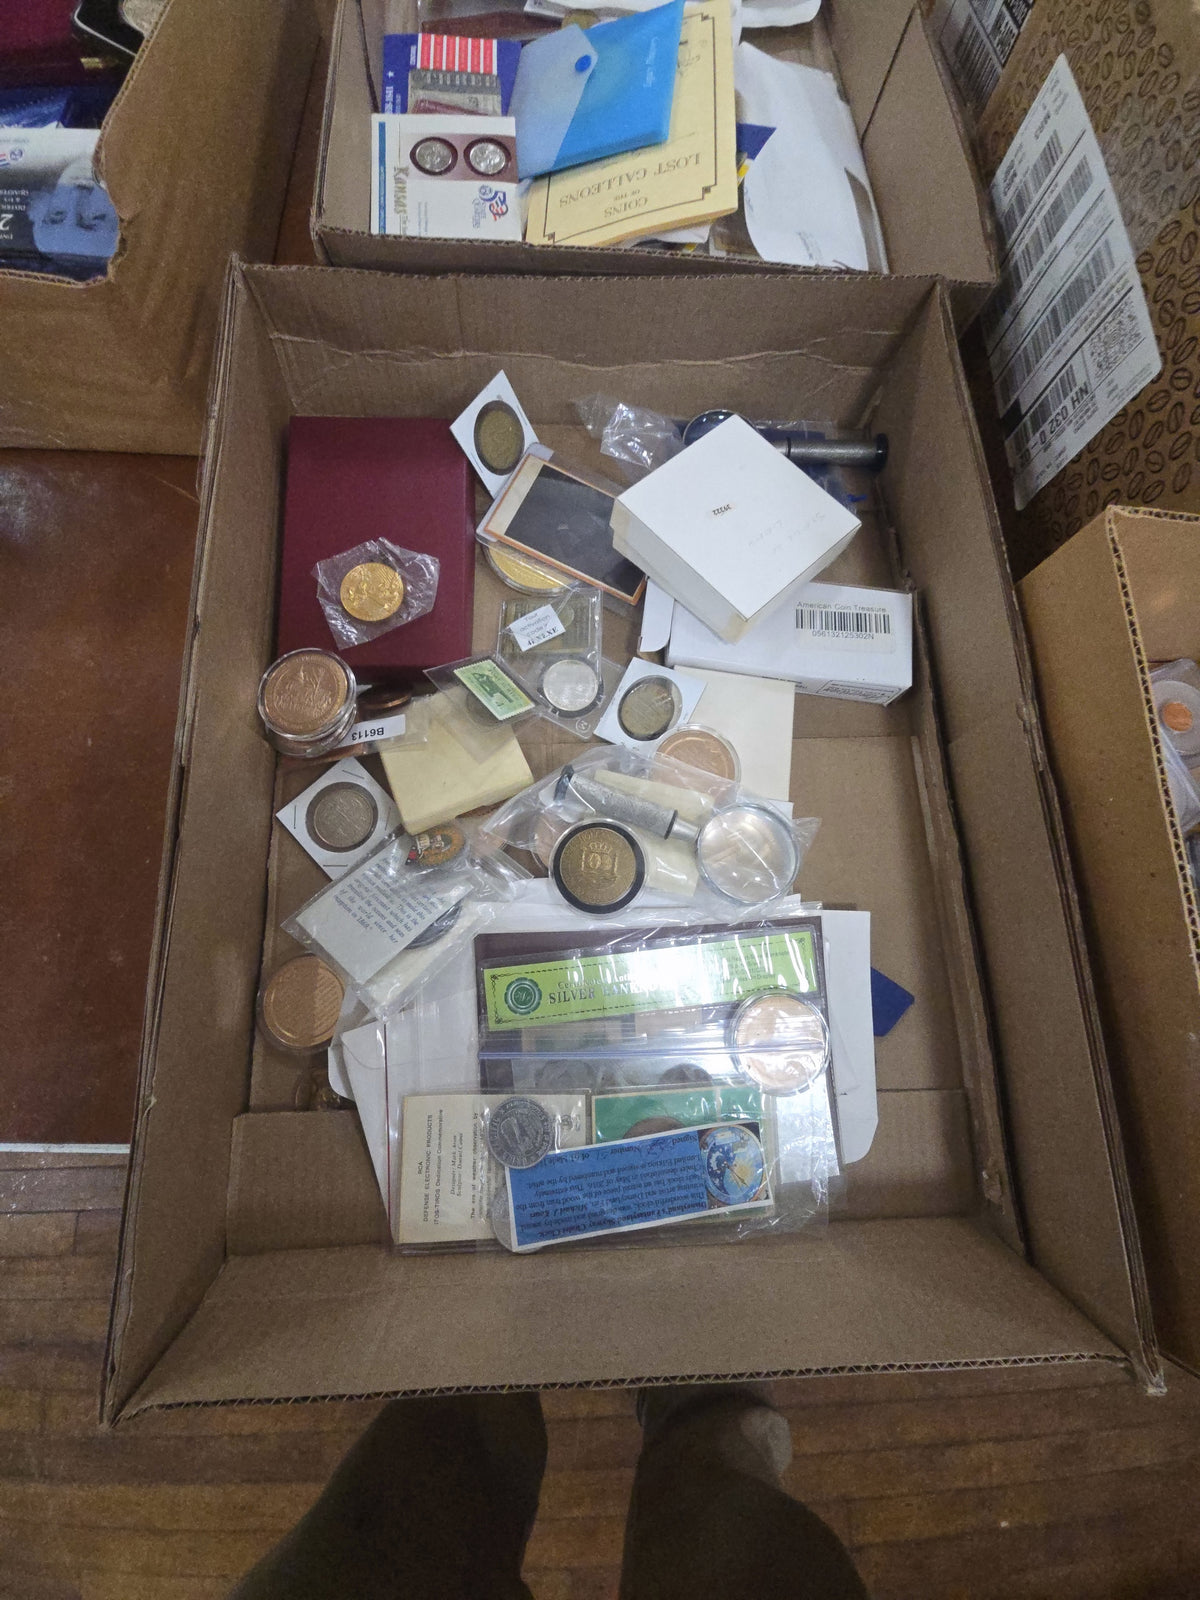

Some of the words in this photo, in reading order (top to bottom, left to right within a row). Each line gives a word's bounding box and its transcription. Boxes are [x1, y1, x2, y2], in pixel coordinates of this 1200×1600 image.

[652, 152, 700, 175] LOST
[394, 166, 409, 214] Kansas
[602, 196, 648, 217] COINS
[1066, 381, 1093, 410] NH
[1044, 404, 1072, 434] 032
[796, 601, 832, 609] American
[853, 604, 886, 612] Treasure
[350, 726, 385, 740] B6113
[547, 986, 595, 1004] SILVER
[671, 1133, 697, 1145] Signed
[609, 1145, 640, 1157] Number
[559, 1203, 587, 1214] Michael
[661, 1200, 706, 1215] Disneyland's
